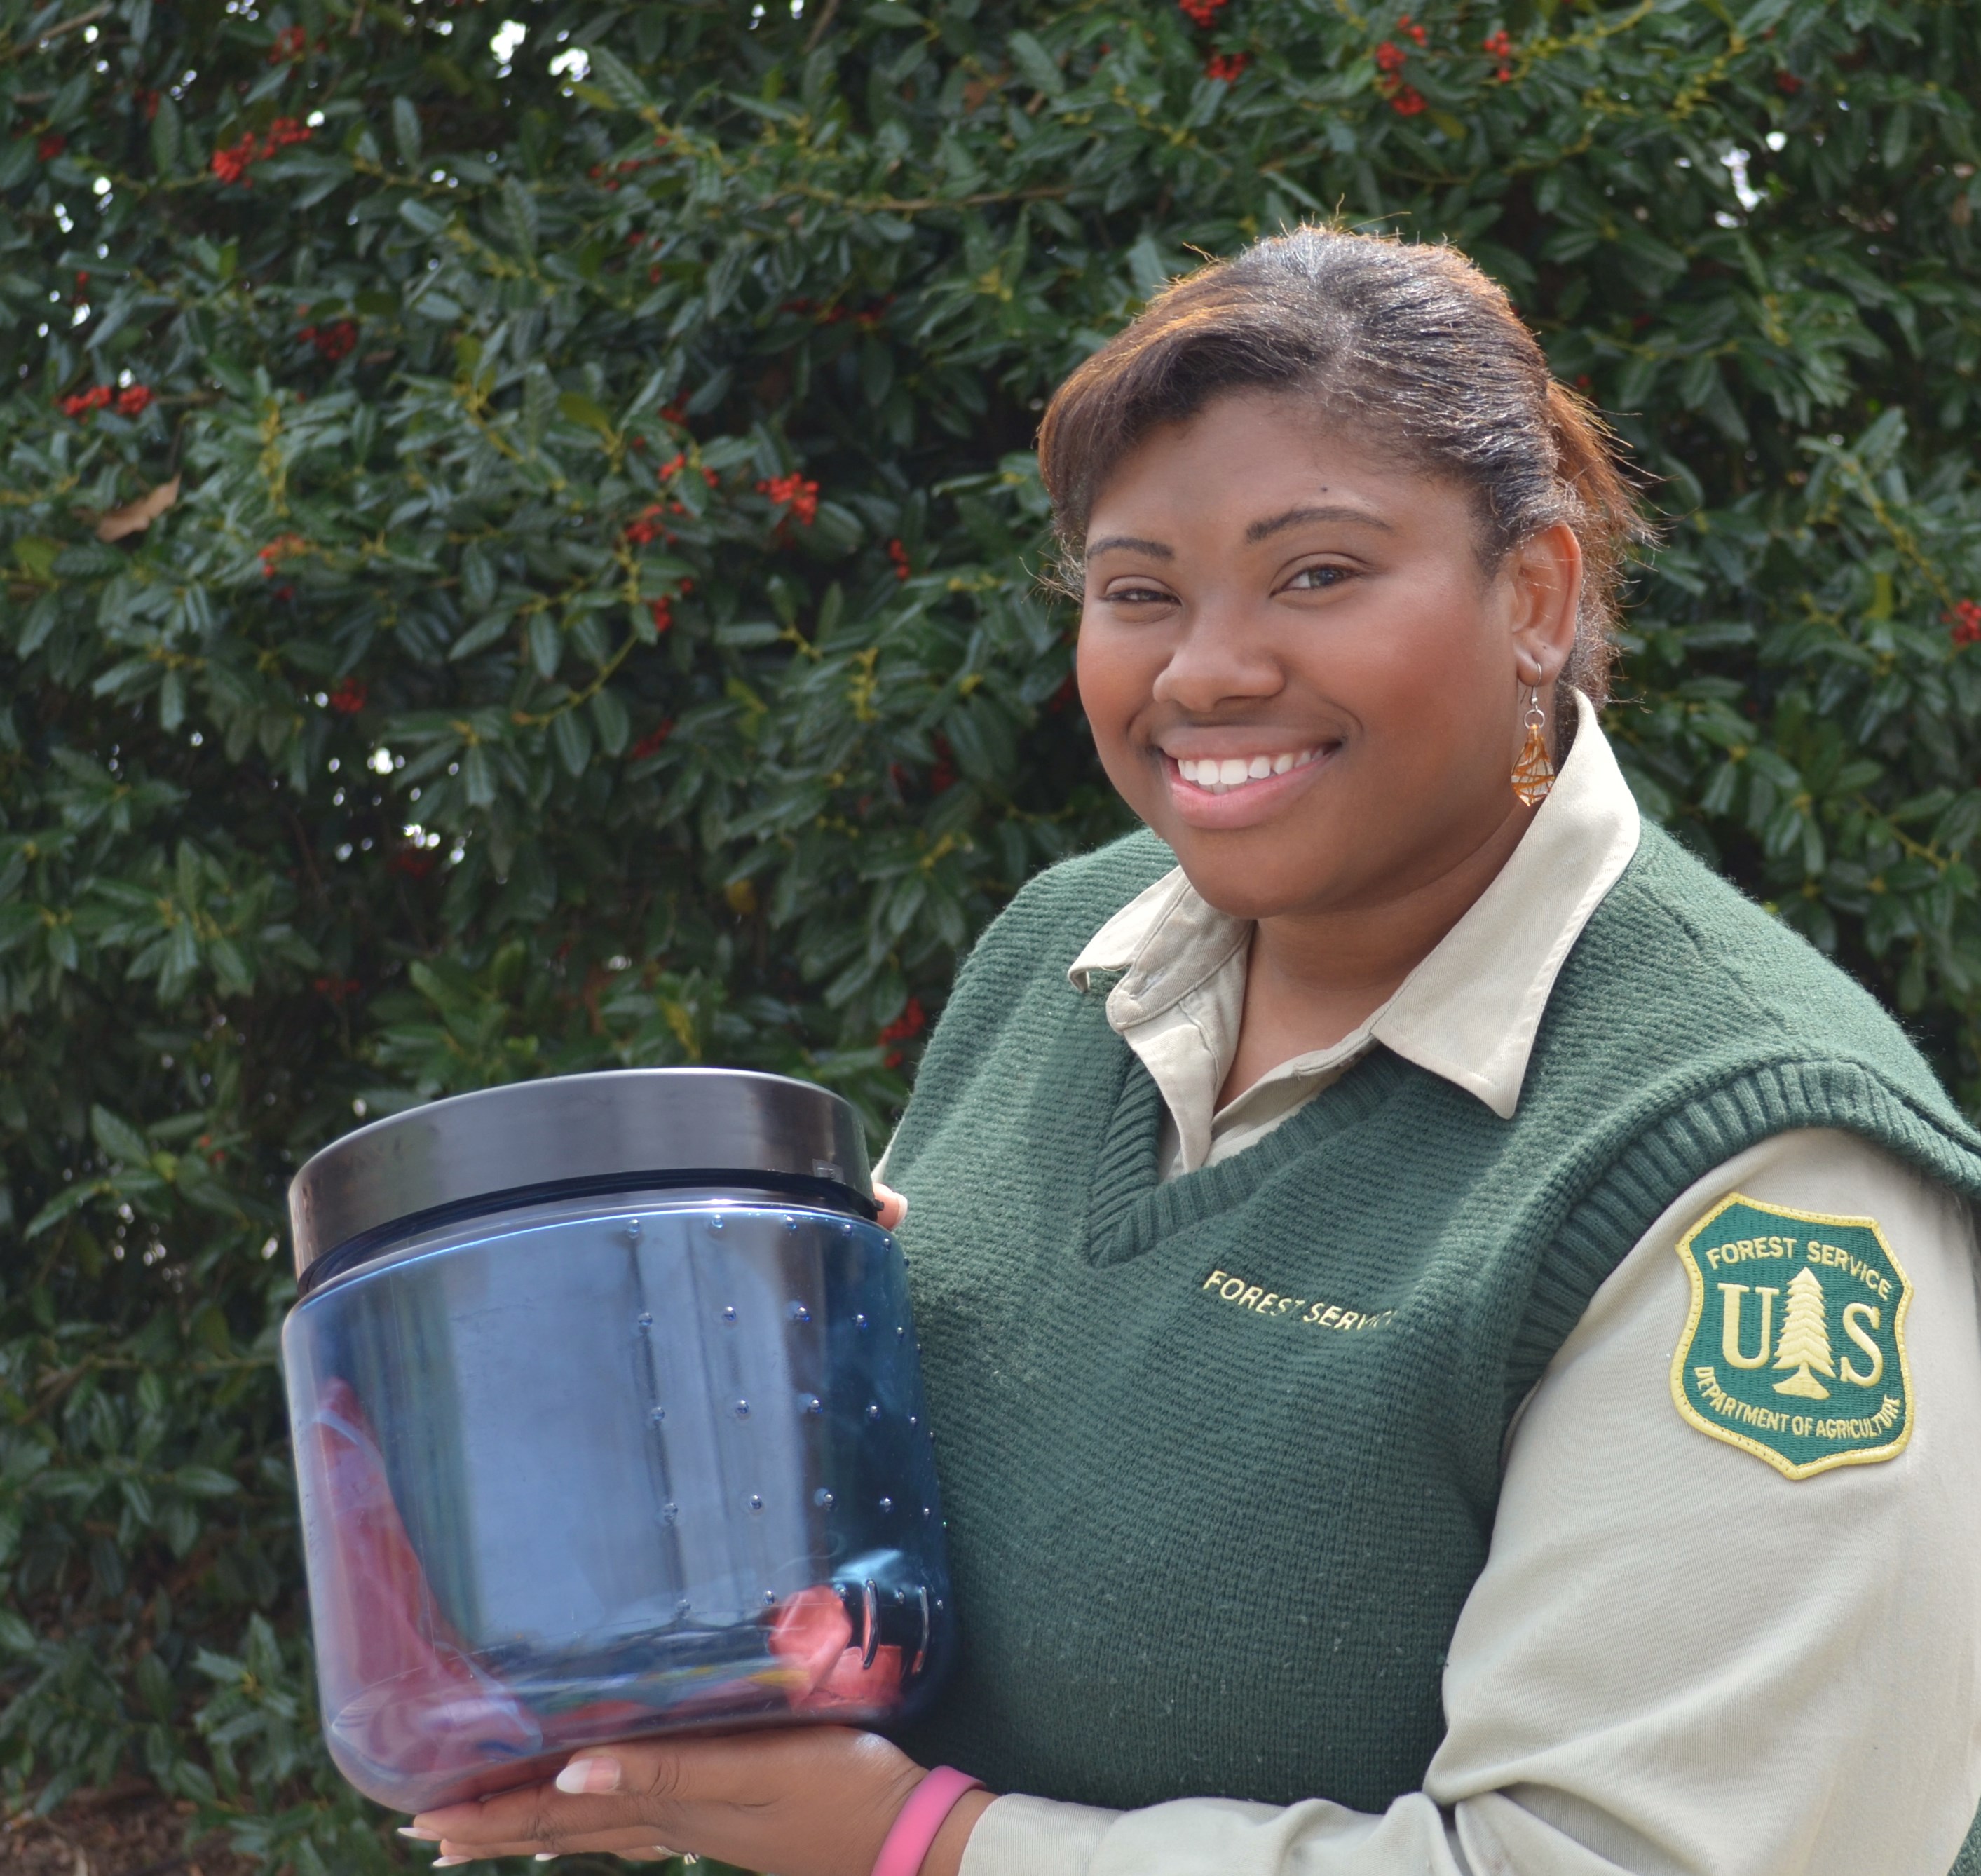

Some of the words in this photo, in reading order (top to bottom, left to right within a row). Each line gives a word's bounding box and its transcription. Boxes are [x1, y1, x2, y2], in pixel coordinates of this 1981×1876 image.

[1706, 1236, 1797, 1270] FOREST
[1806, 1241, 1892, 1300] SERVICE
[1717, 1282, 1780, 1370] U
[1839, 1303, 1884, 1387] S
[1694, 1366, 1790, 1432] DEPARTMENT
[1792, 1415, 1813, 1437] OF
[1816, 1394, 1900, 1439] AGRICULTURE
